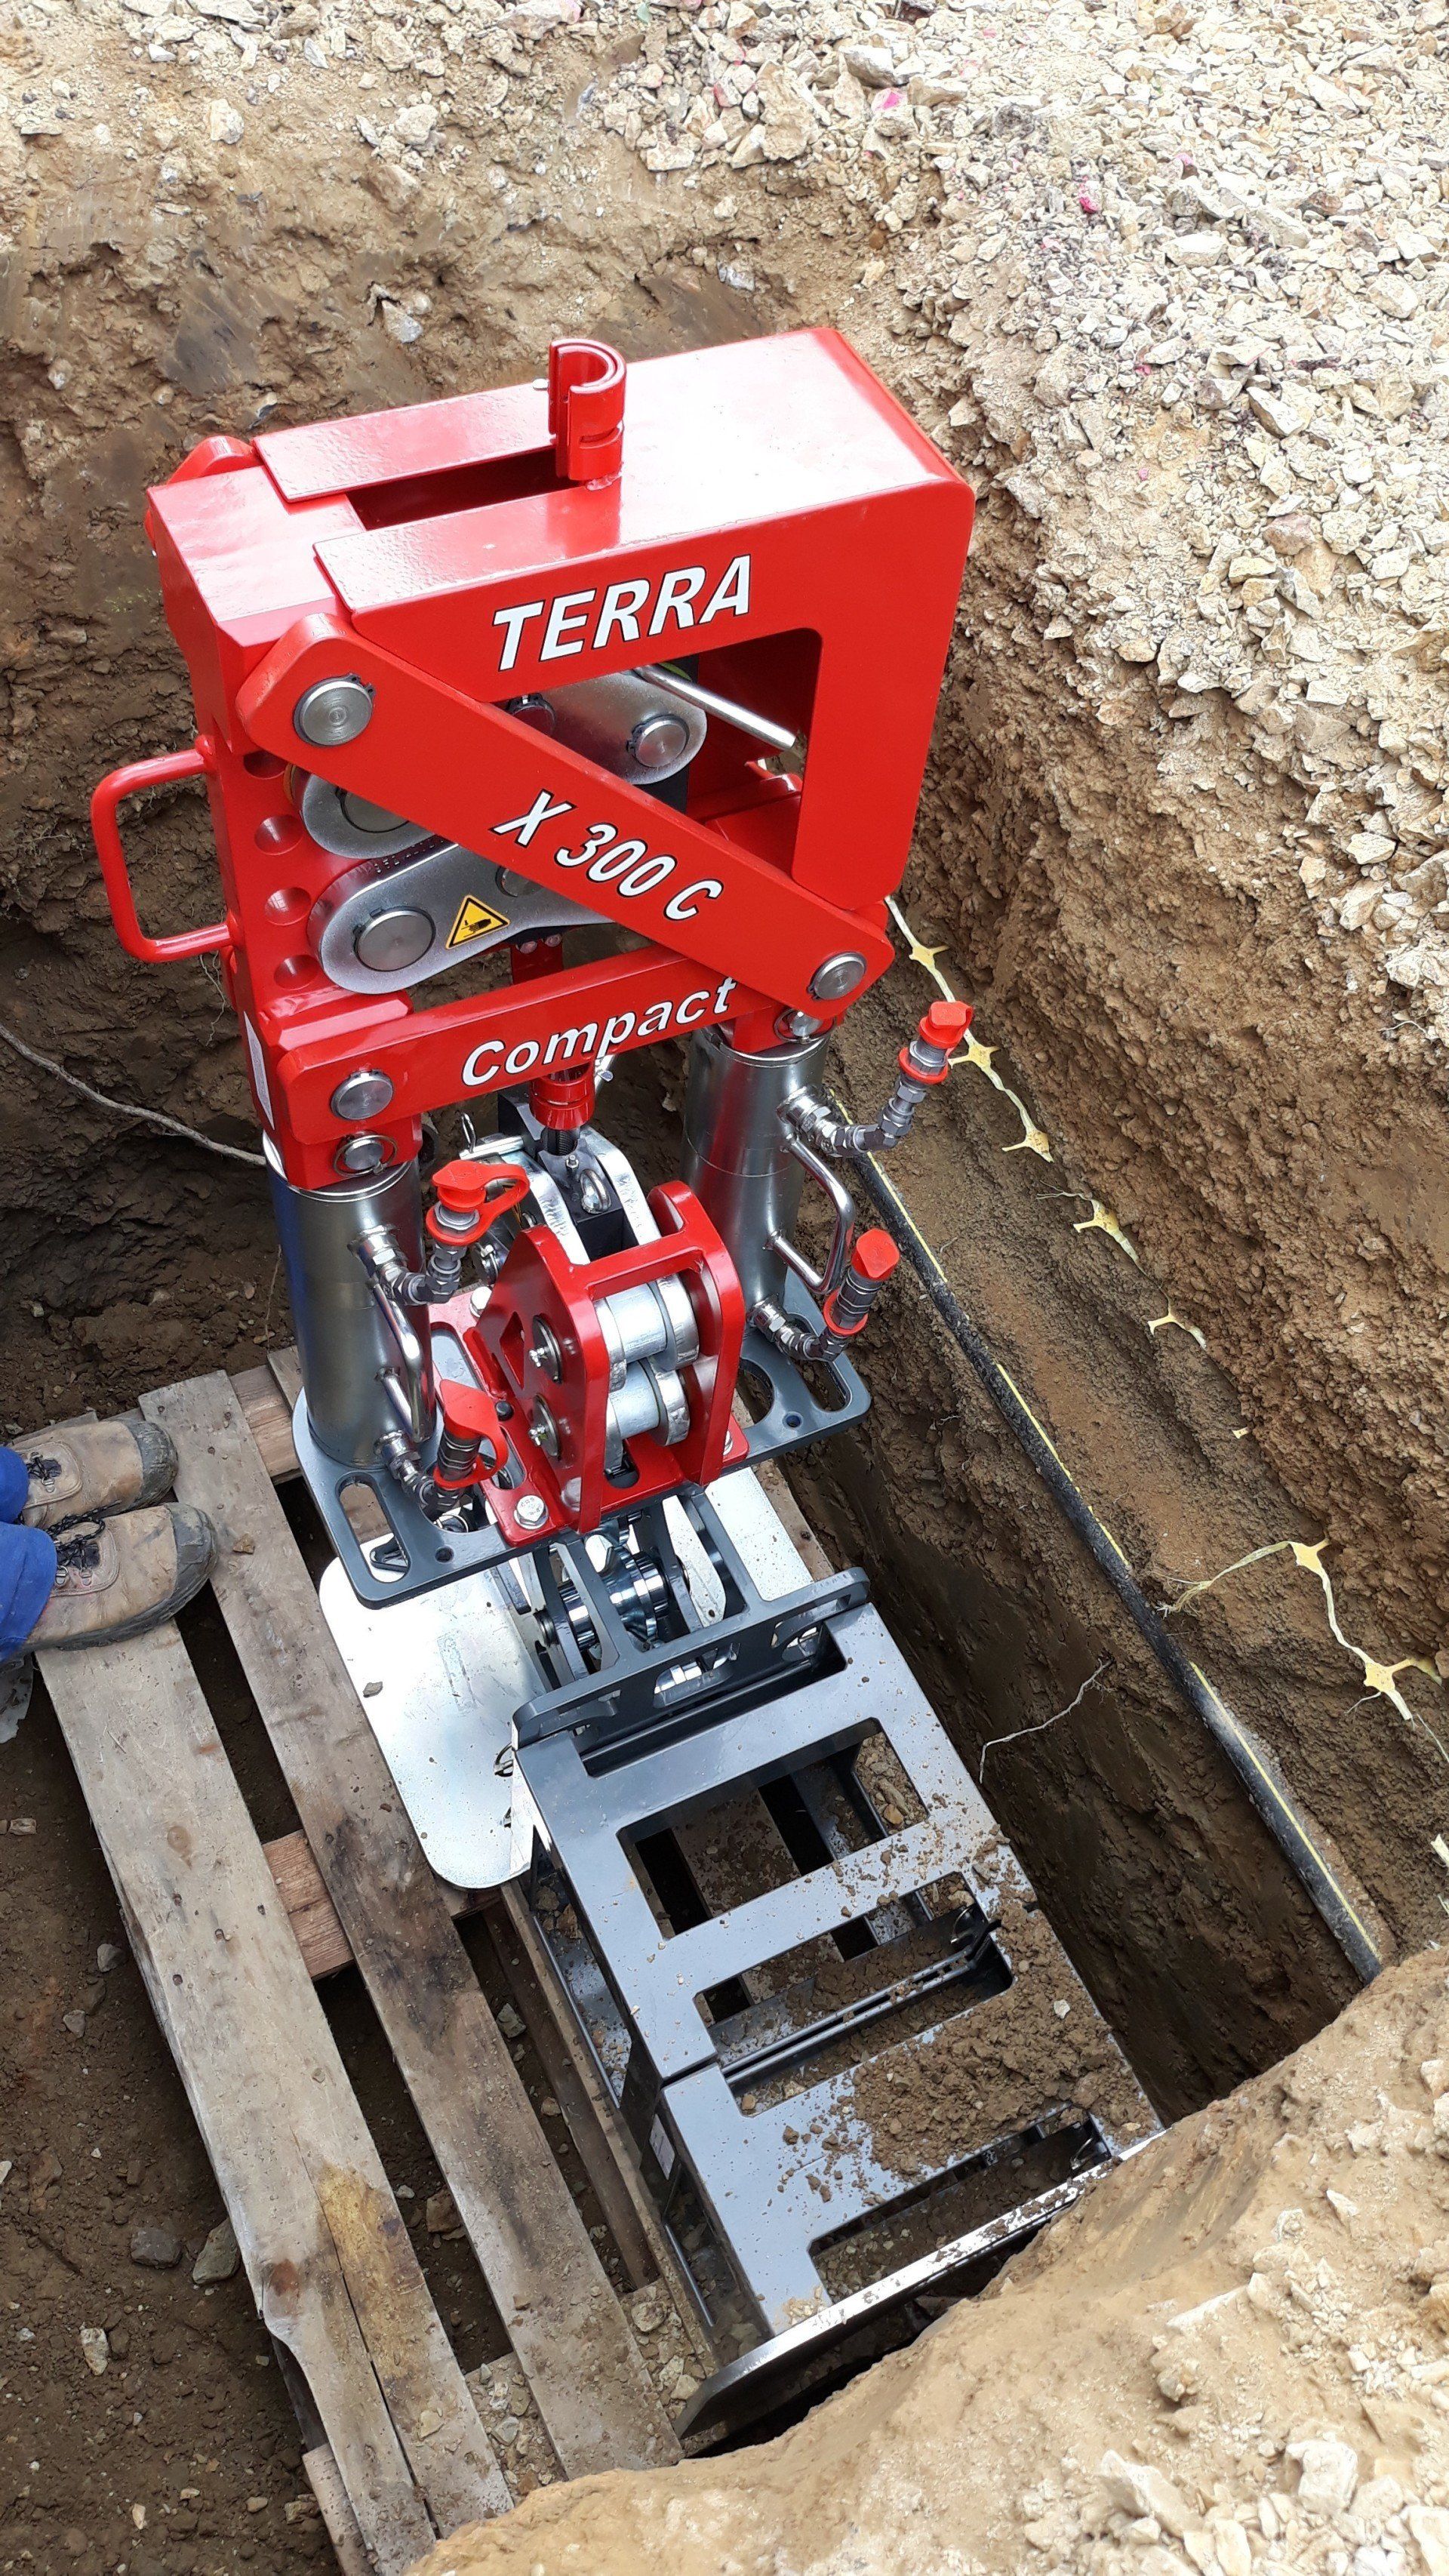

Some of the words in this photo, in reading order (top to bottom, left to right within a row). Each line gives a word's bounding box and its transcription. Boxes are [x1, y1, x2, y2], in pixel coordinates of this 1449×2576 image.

[493, 554, 751, 672] TERRA
[489, 789, 577, 848] X
[554, 823, 677, 897] 300
[663, 879, 724, 921] C
[462, 977, 737, 1087] Compact
